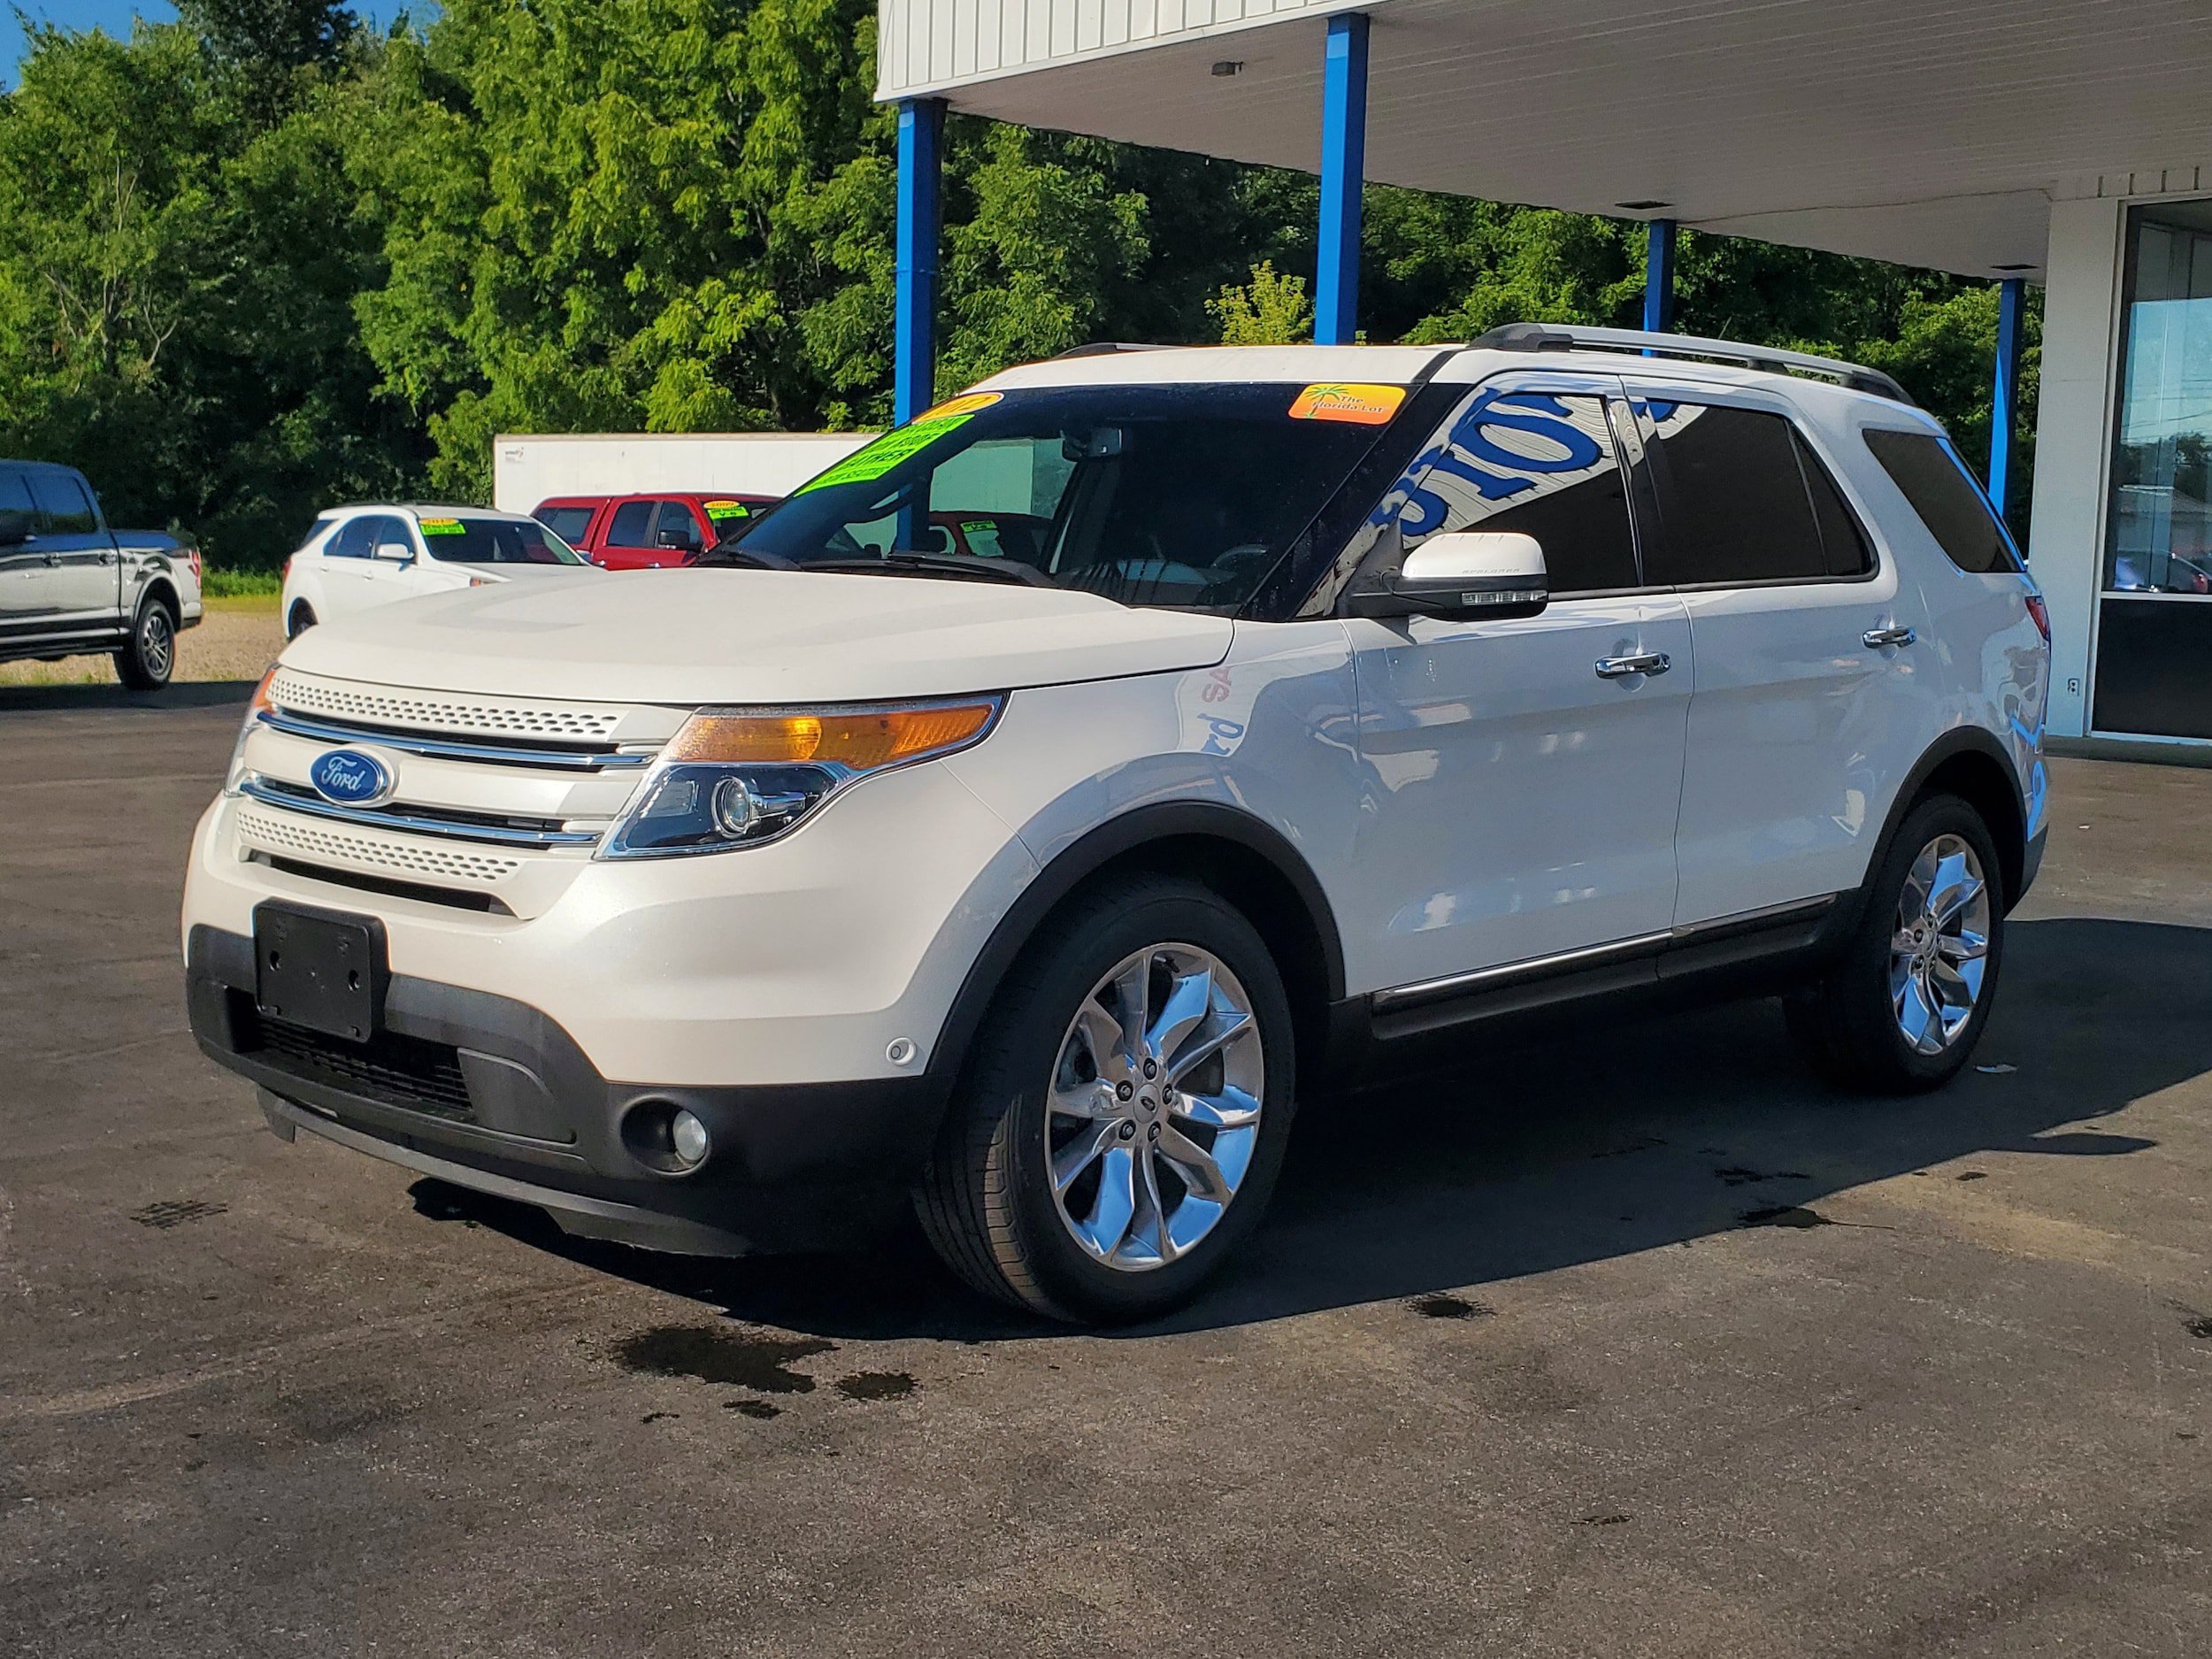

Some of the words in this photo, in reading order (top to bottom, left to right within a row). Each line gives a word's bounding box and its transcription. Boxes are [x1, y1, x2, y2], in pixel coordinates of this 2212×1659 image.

[1312, 401, 1357, 411] Florida
[1362, 404, 1383, 413] Lot
[321, 757, 365, 790] Ford
